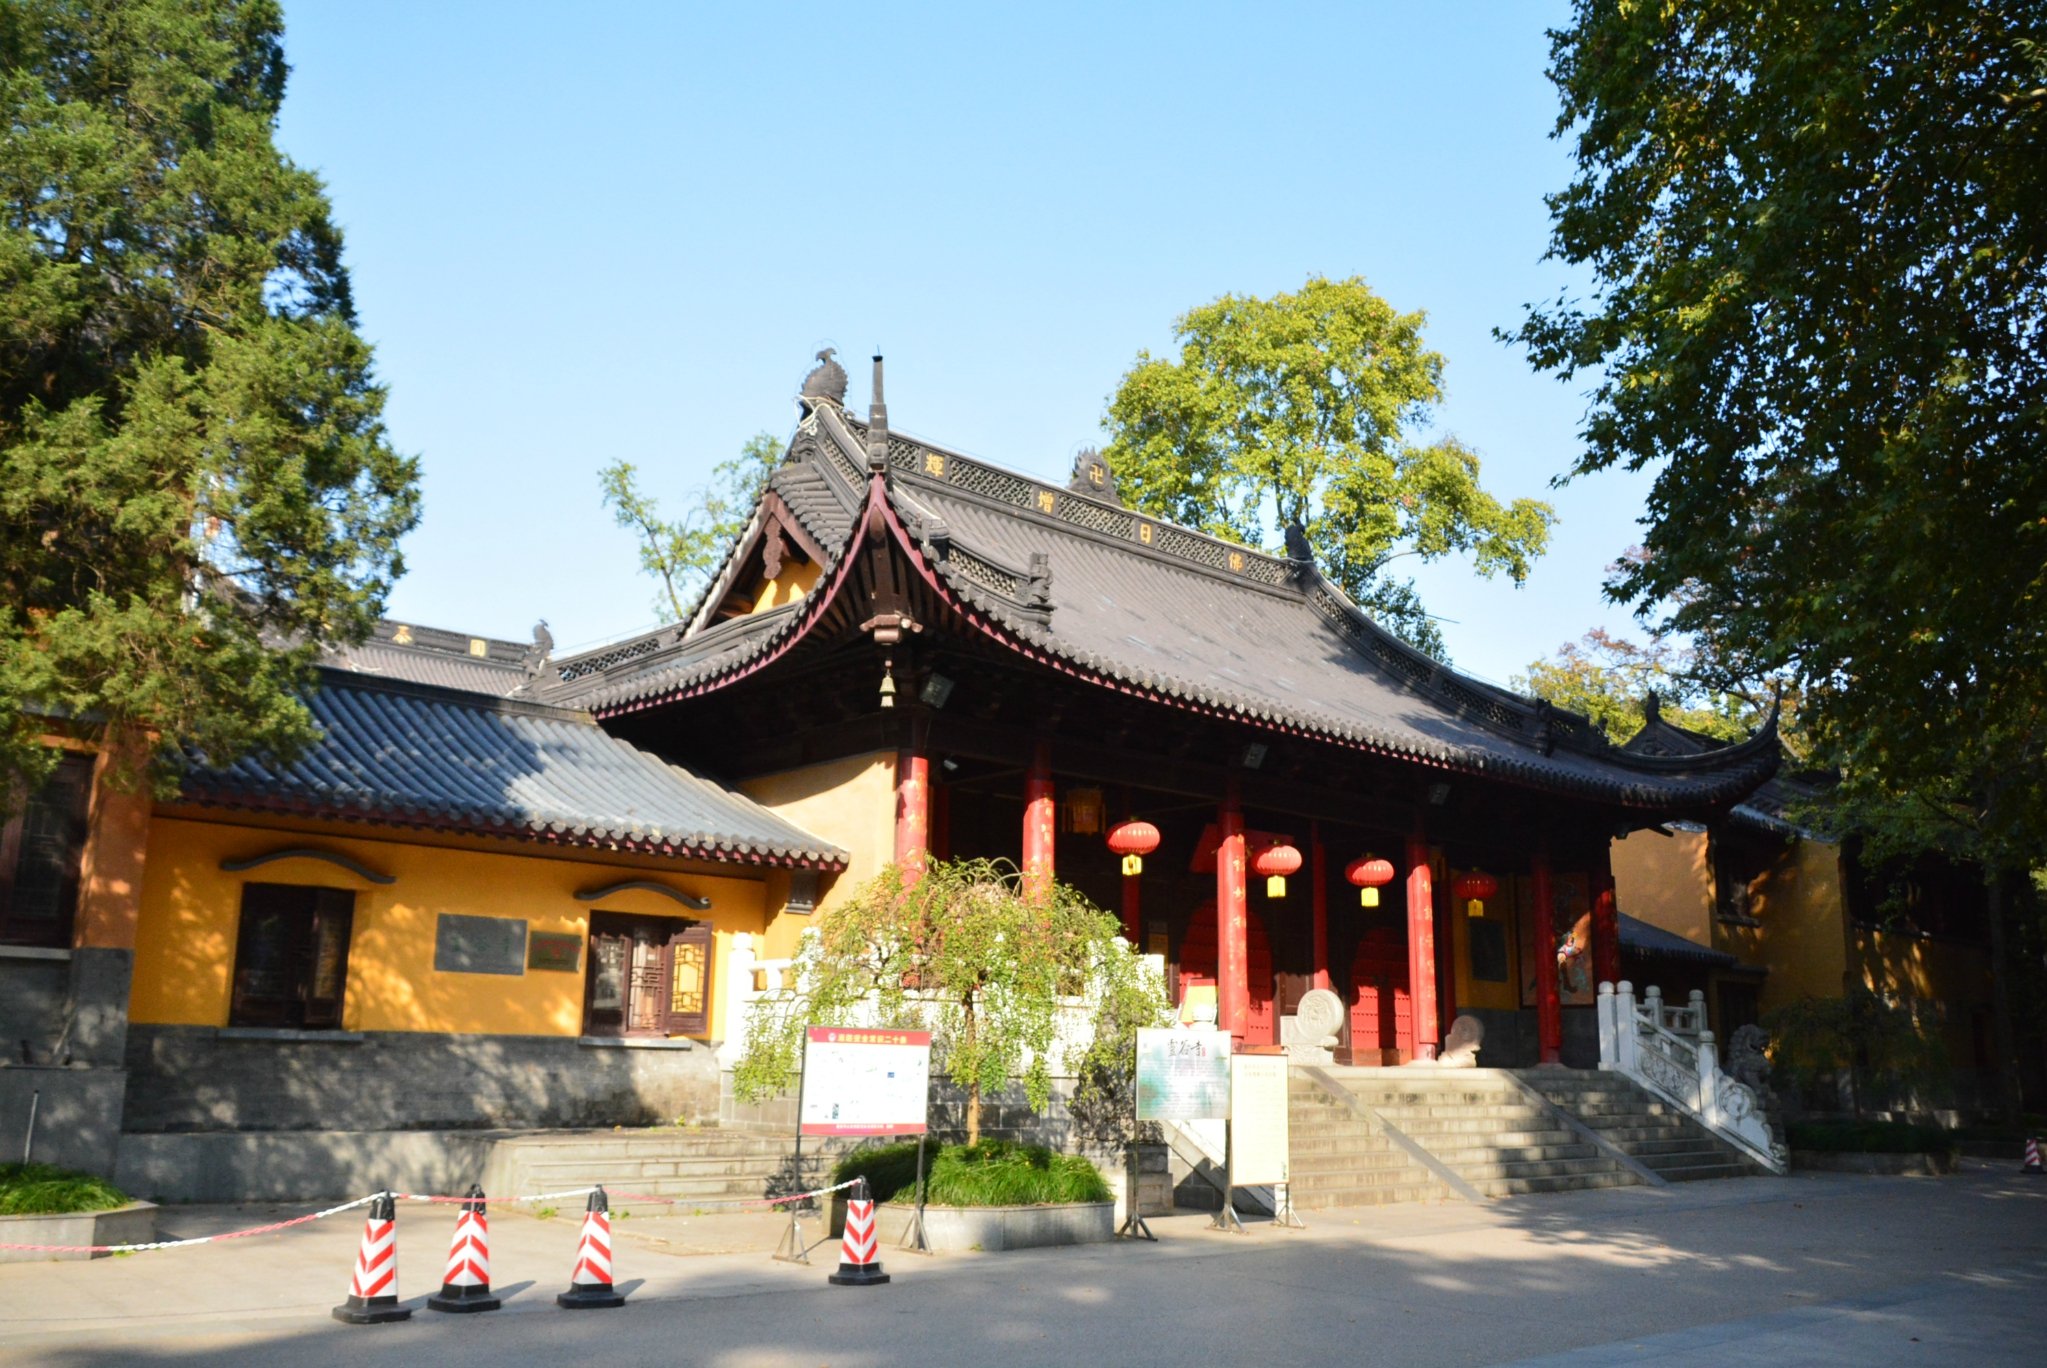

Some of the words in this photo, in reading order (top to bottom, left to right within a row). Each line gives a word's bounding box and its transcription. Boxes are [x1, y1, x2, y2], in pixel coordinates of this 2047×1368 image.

[924, 452, 945, 477] 輝
[1037, 490, 1055, 513] 增
[1139, 523, 1152, 544] 日
[1228, 551, 1243, 572] 佛
